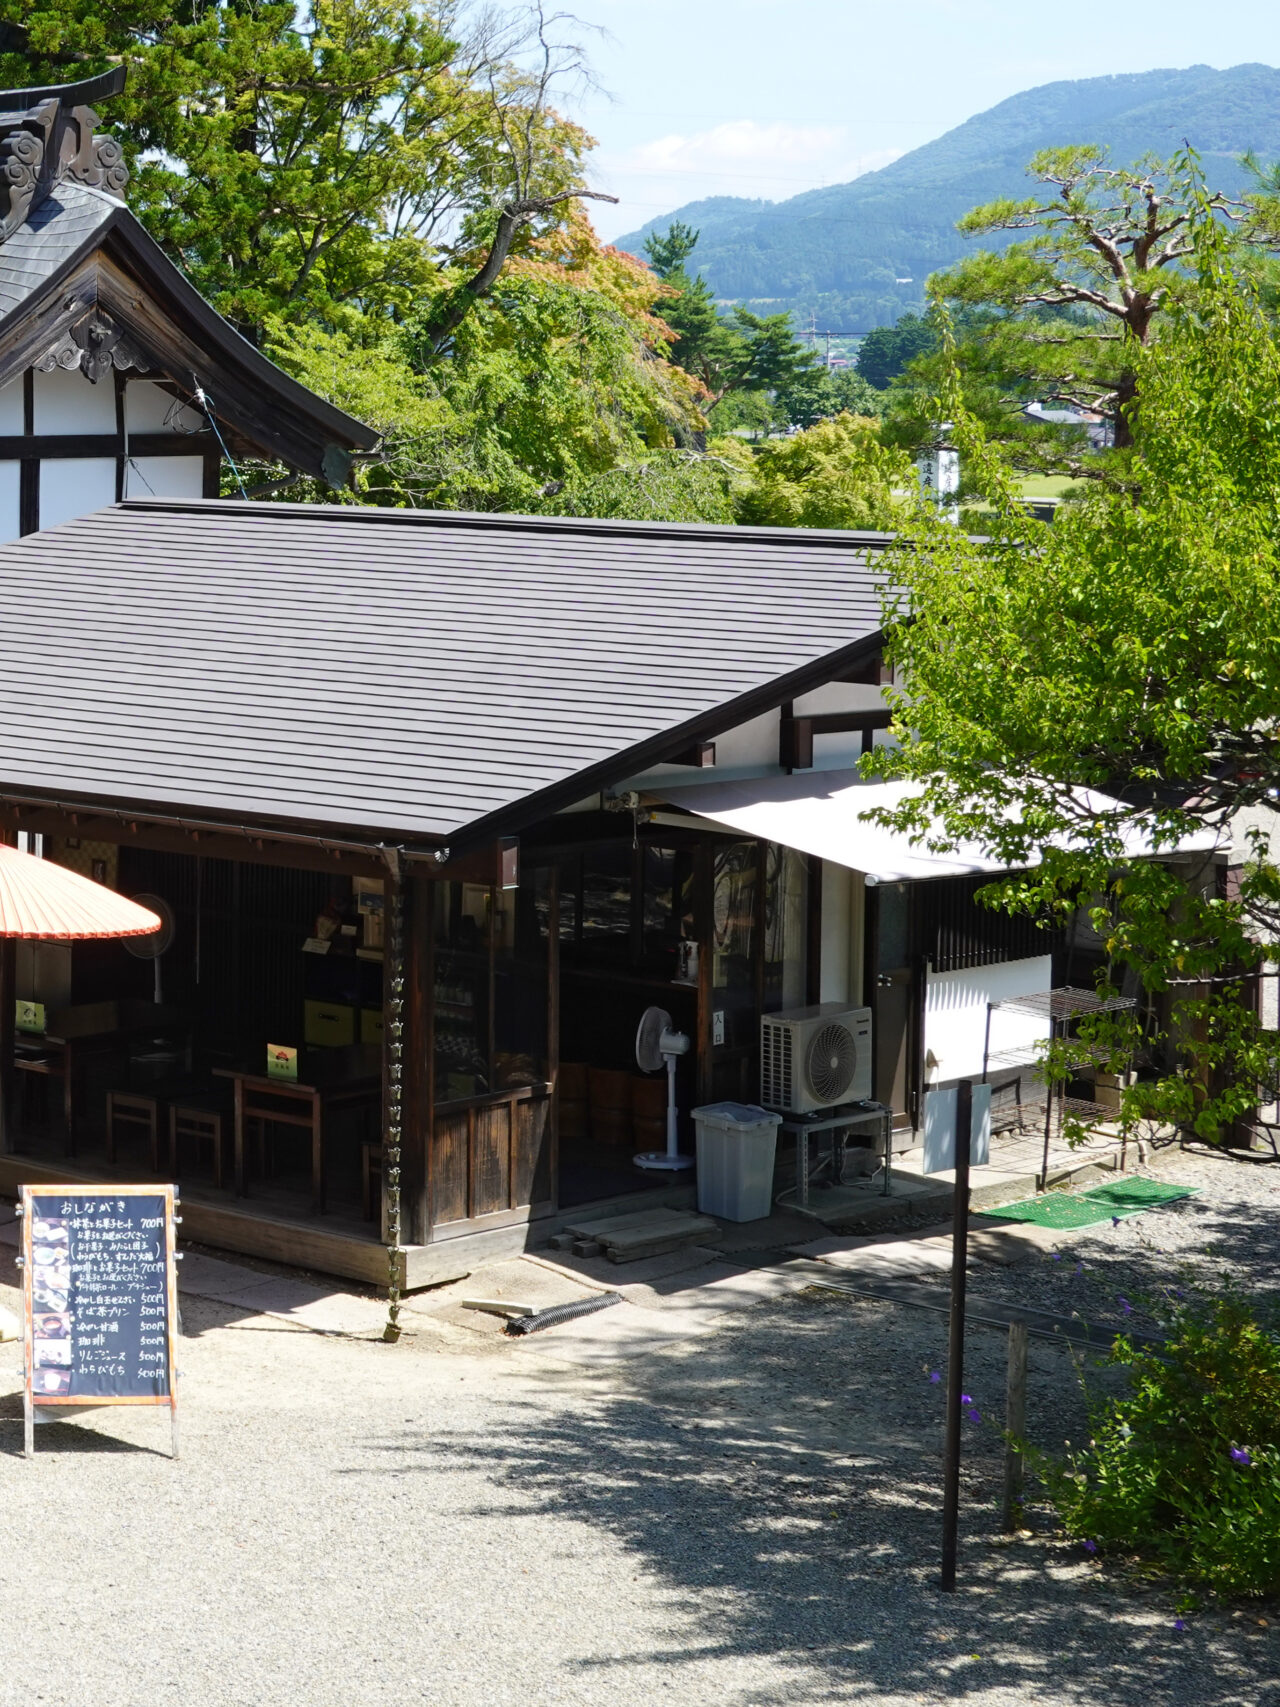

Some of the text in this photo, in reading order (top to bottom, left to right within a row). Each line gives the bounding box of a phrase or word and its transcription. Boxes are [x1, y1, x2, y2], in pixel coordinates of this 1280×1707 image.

[715, 1013, 723, 1043] 入口
[61, 1201, 125, 1214] おしながき
[141, 1217, 164, 1229] 700円
[141, 1261, 164, 1273] 700円
[141, 1293, 164, 1305] 500円
[77, 1305, 165, 1318] そば茶プリン 500円
[76, 1321, 164, 1332] 冷やし甘酒 500円
[78, 1333, 164, 1346] 珈琲 500円
[79, 1350, 164, 1362] りんごジュース 500円
[79, 1363, 125, 1375] わらびもち
